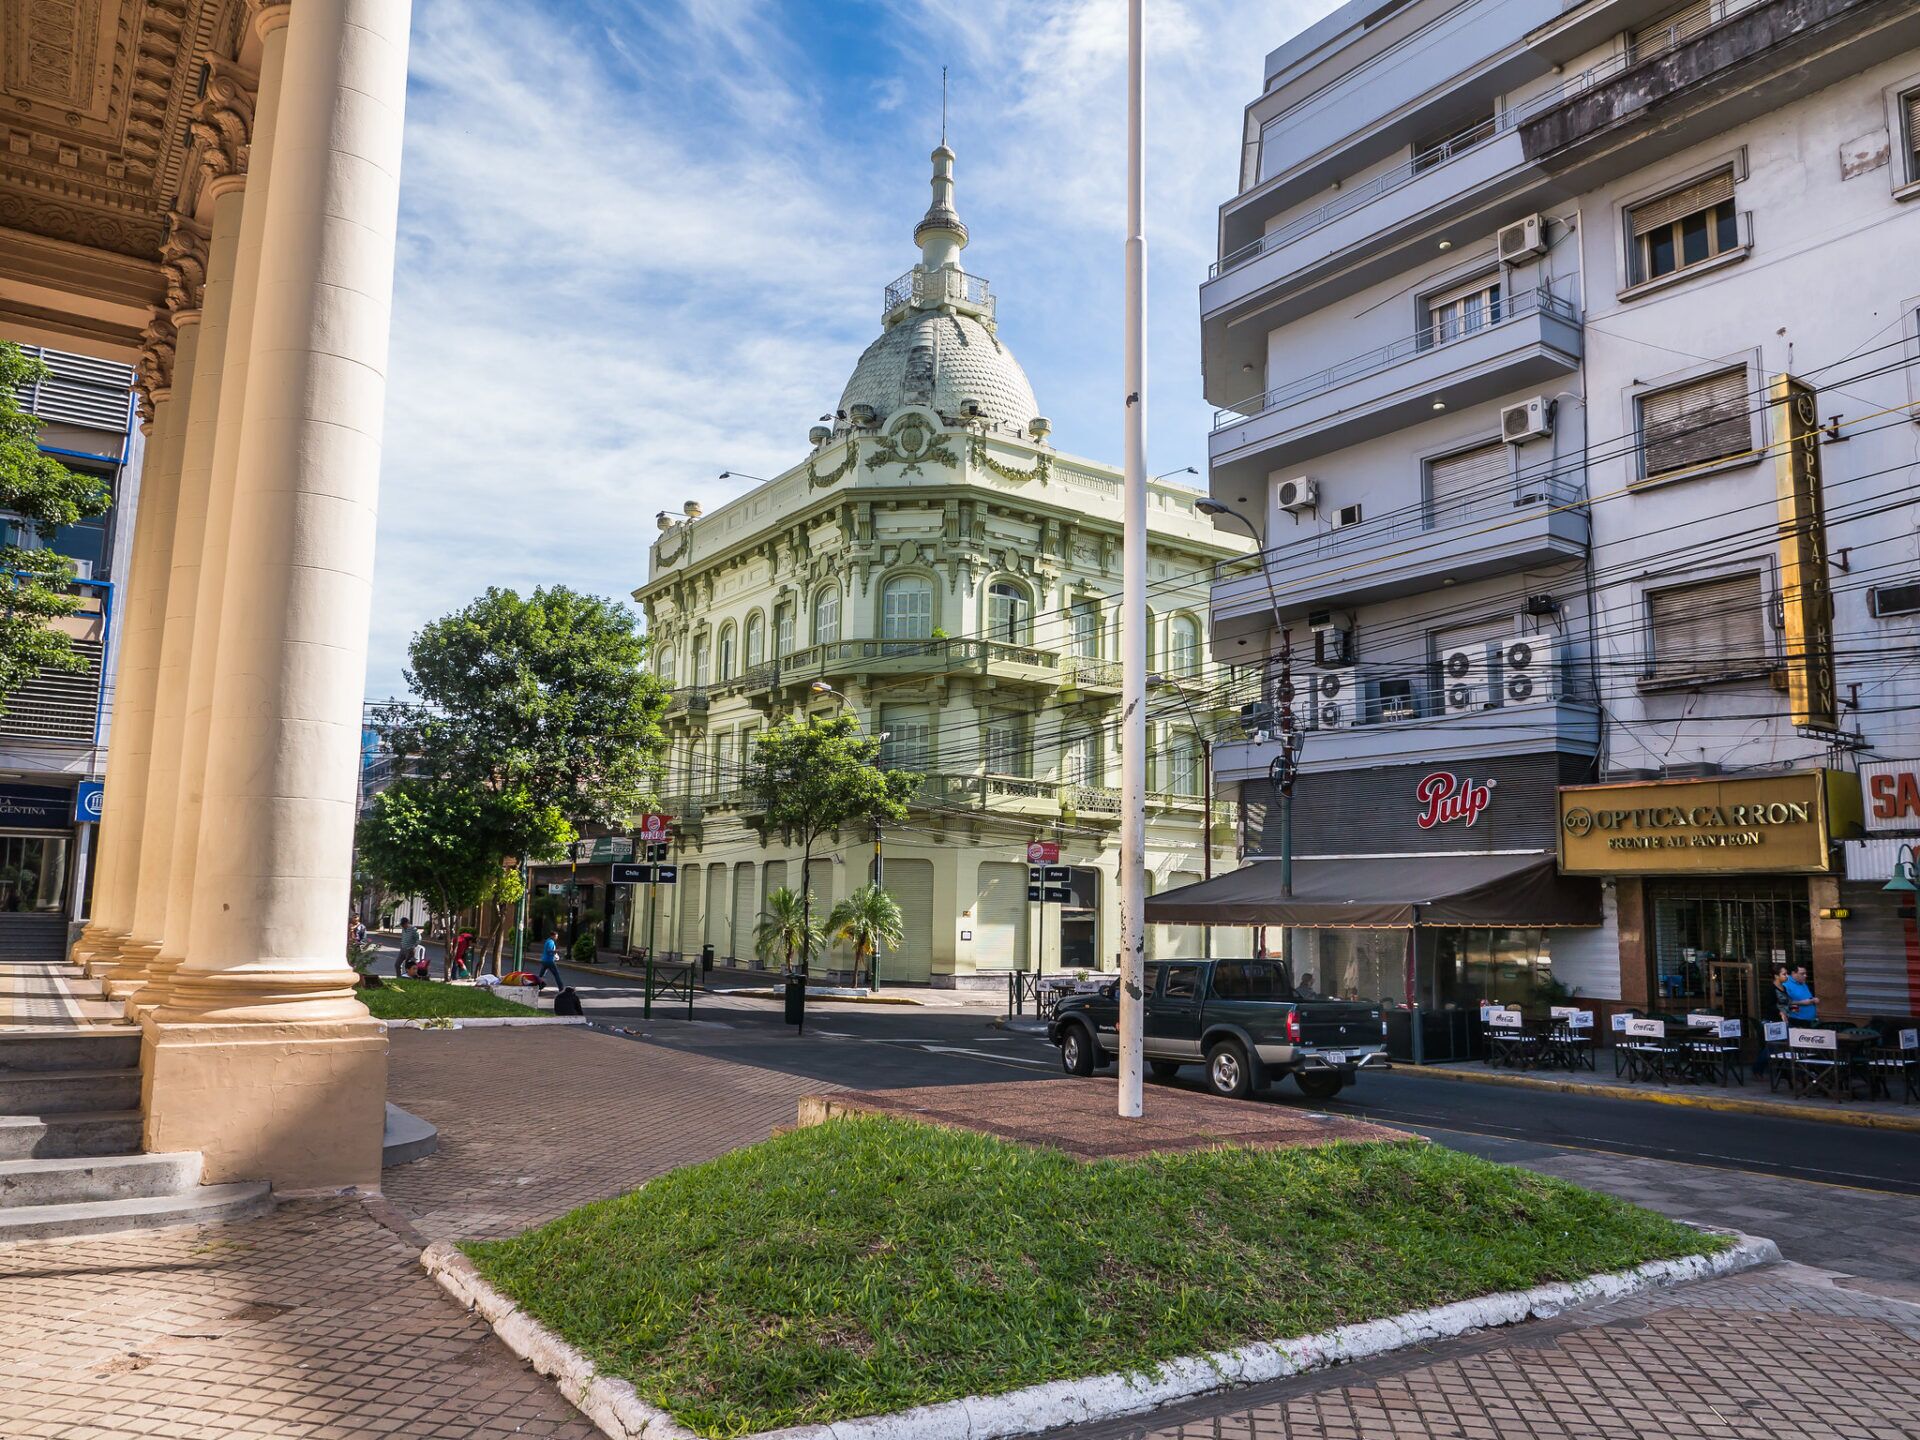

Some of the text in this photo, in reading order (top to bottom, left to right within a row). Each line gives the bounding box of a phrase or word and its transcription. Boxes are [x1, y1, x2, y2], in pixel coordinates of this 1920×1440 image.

[1416, 771, 1491, 829] Pulp
[1607, 831, 1761, 850] FRENTE AL PANTEON
